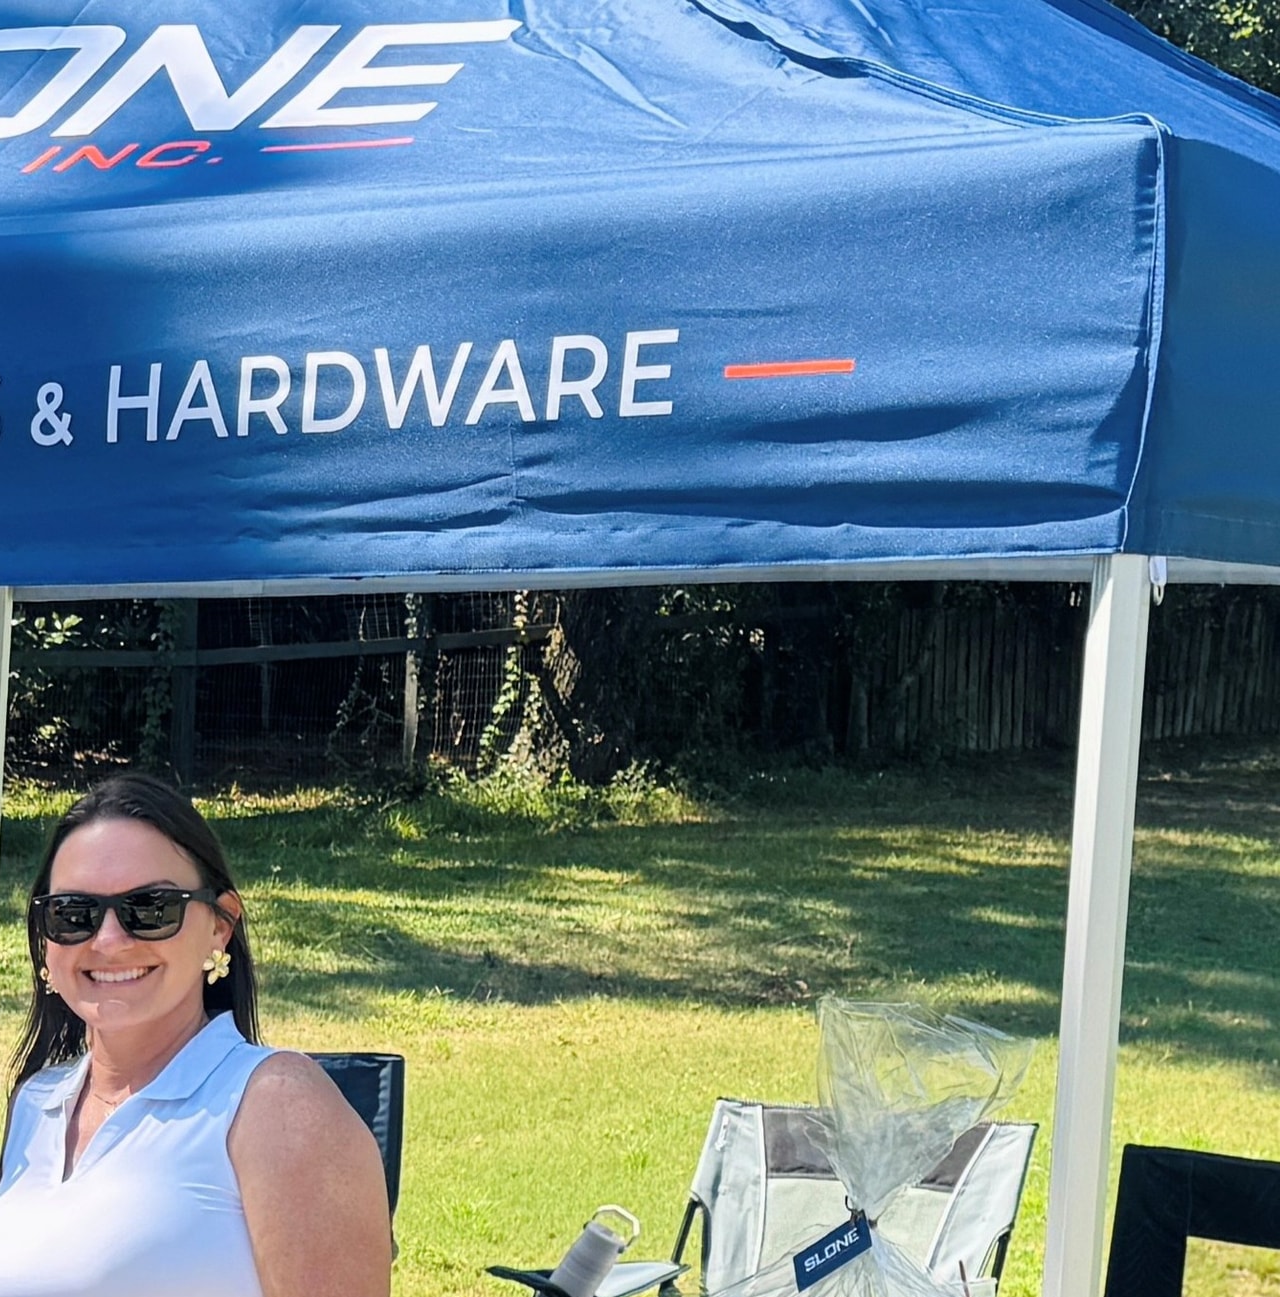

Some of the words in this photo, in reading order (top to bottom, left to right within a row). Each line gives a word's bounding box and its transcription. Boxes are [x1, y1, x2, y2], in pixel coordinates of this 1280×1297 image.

[23, 140, 223, 175] INC.
[38, 382, 74, 447] &
[106, 329, 679, 443] HARDWARE
[804, 1227, 860, 1272] SLONE
